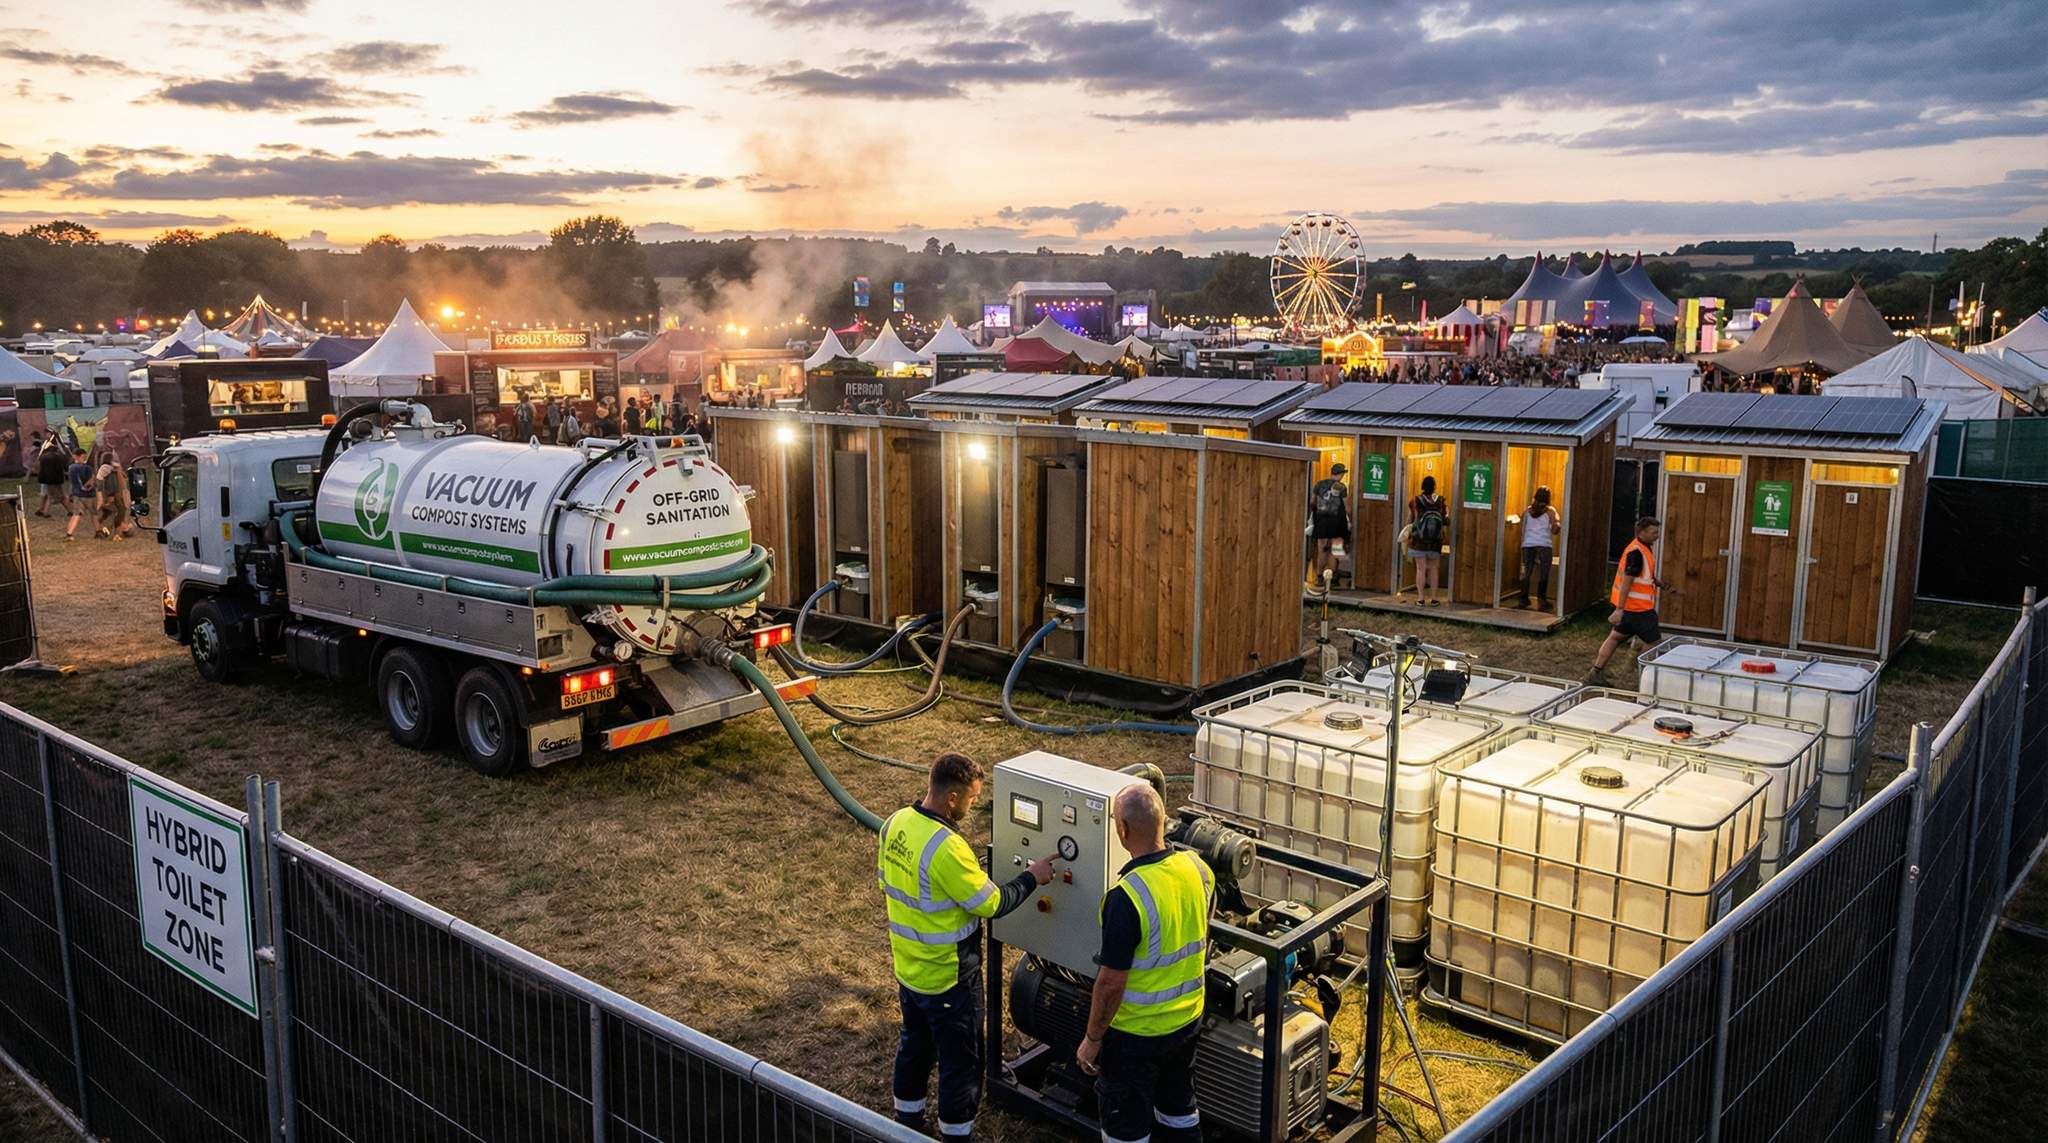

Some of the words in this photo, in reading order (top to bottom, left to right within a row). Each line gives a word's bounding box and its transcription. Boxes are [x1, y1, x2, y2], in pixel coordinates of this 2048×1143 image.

[424, 471, 537, 512] VACUUM
[652, 488, 720, 507] OFF-GRID
[411, 505, 469, 529] COMPOST
[470, 512, 527, 536] SYSTEMS
[645, 503, 730, 526] SANITATION
[145, 805, 228, 875] HYBRID
[152, 856, 228, 926] TOILET
[164, 909, 226, 974] ZONE
